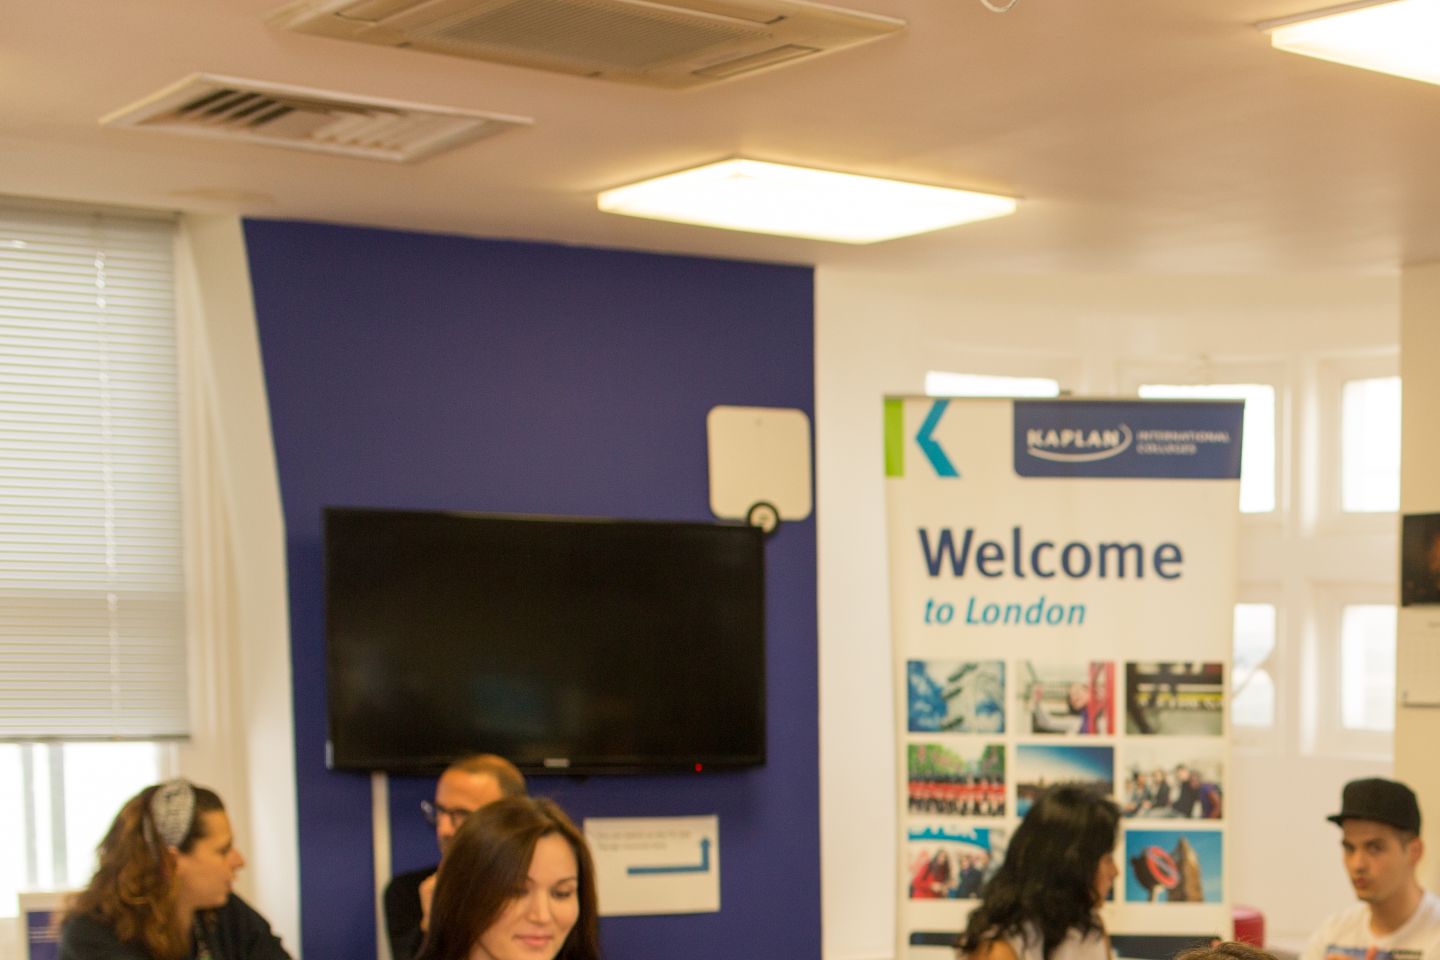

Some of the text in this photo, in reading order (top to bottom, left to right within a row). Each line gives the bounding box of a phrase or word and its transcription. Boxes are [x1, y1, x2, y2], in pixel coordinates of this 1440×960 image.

[1026, 428, 1120, 448] KAPLAN
[919, 527, 1183, 579] Welcome
[923, 596, 1086, 625] to London
